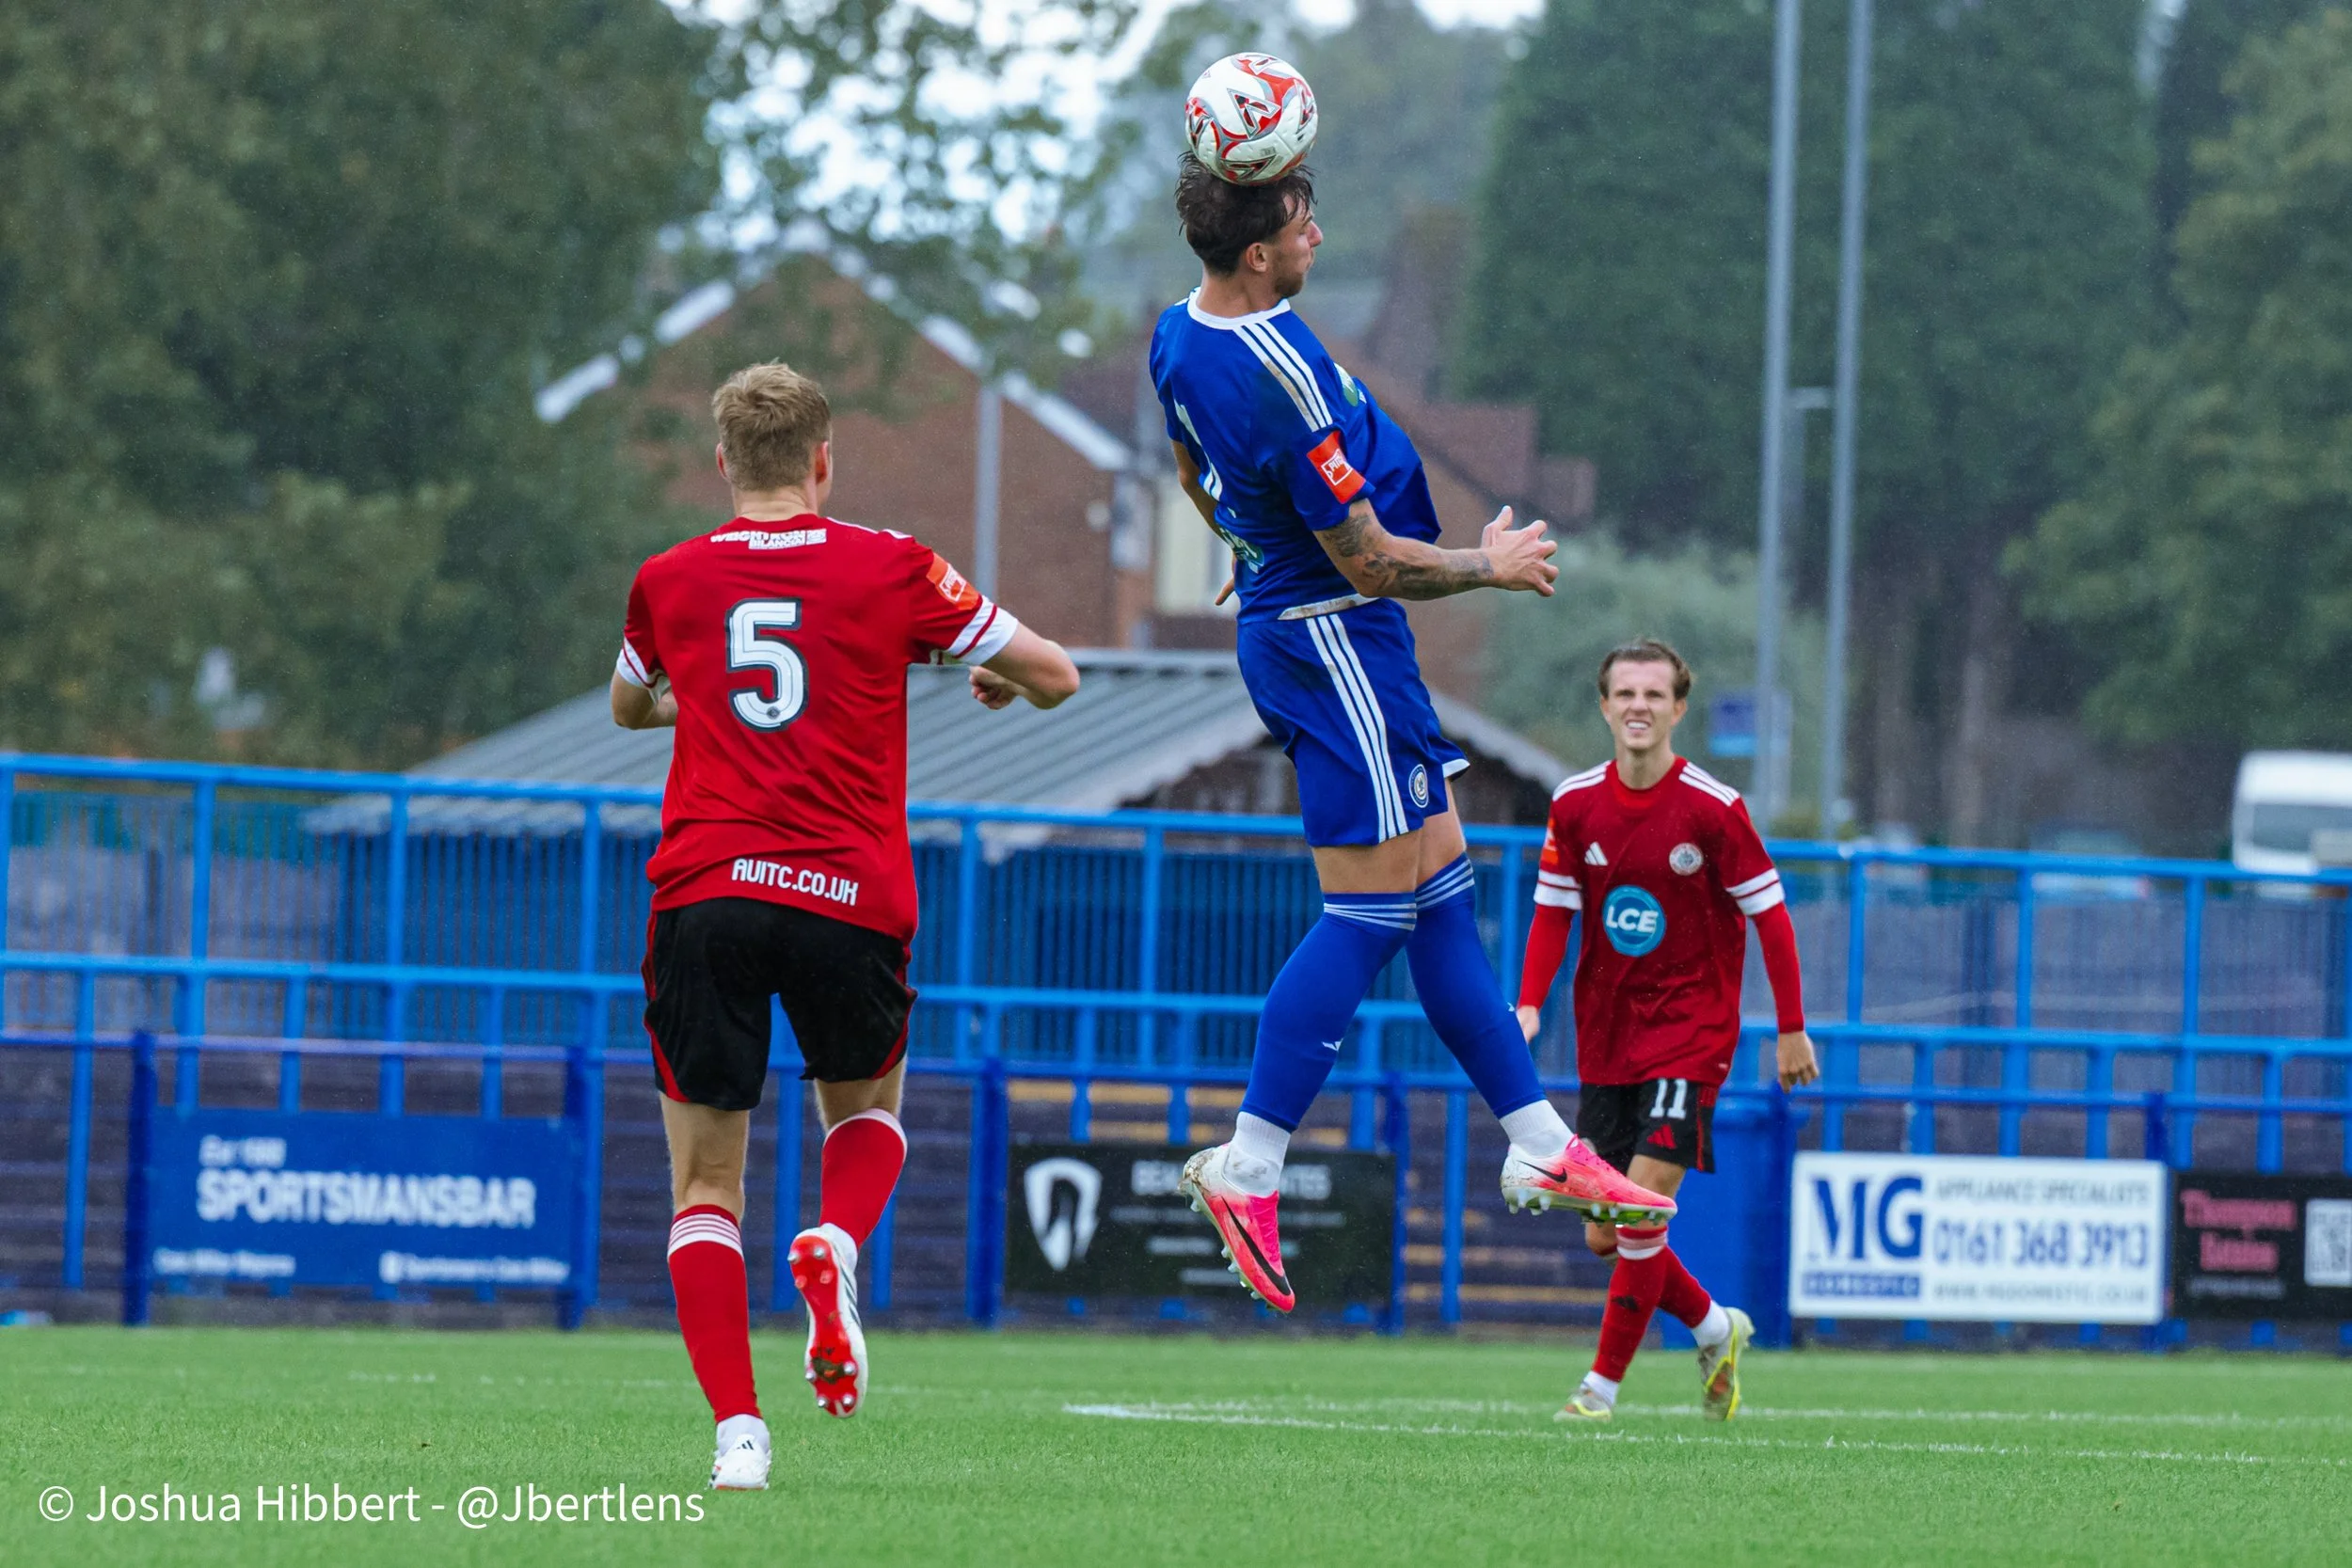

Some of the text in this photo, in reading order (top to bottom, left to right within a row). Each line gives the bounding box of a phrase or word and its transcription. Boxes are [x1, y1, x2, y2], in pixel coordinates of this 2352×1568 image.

[726, 598, 809, 733] 5
[731, 858, 859, 906] AUITC.CO.UK
[1605, 905, 1659, 933] LCE
[1649, 1078, 1687, 1119] 11
[1808, 1175, 1923, 1260] MG
